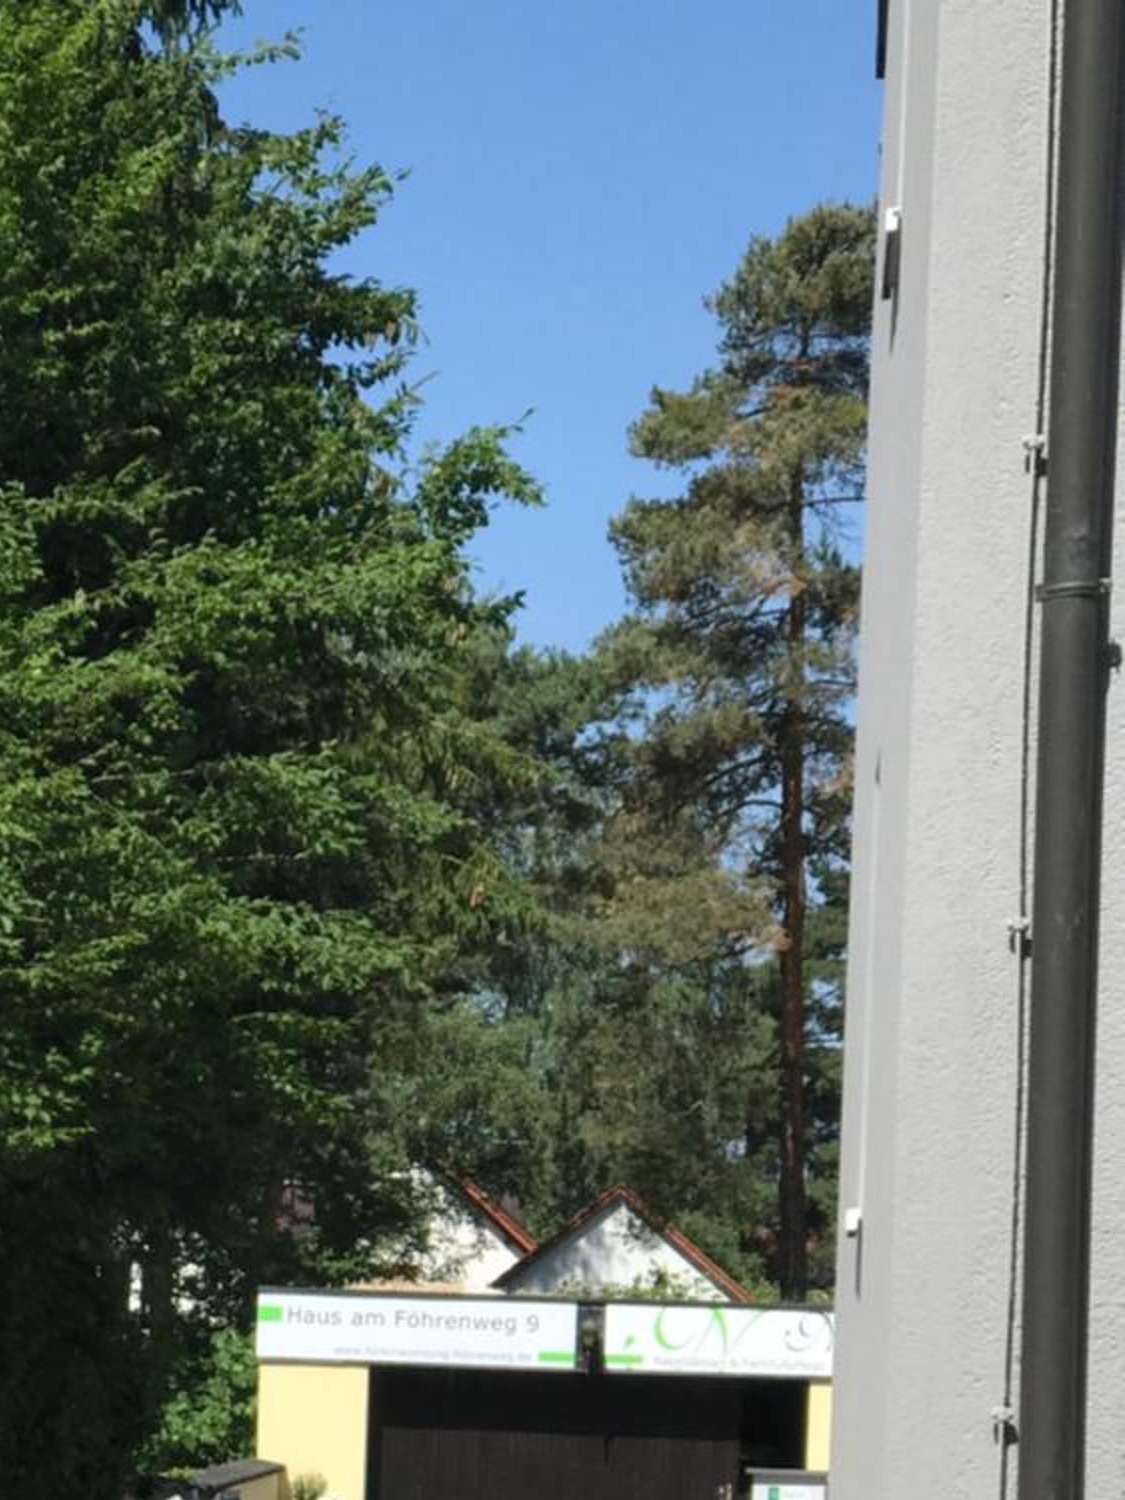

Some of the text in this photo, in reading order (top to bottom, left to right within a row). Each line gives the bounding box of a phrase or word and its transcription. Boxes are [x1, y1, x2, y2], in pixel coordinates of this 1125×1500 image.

[287, 1308, 342, 1326] Haus
[351, 1312, 386, 1327] am
[526, 1314, 540, 1333] 9
